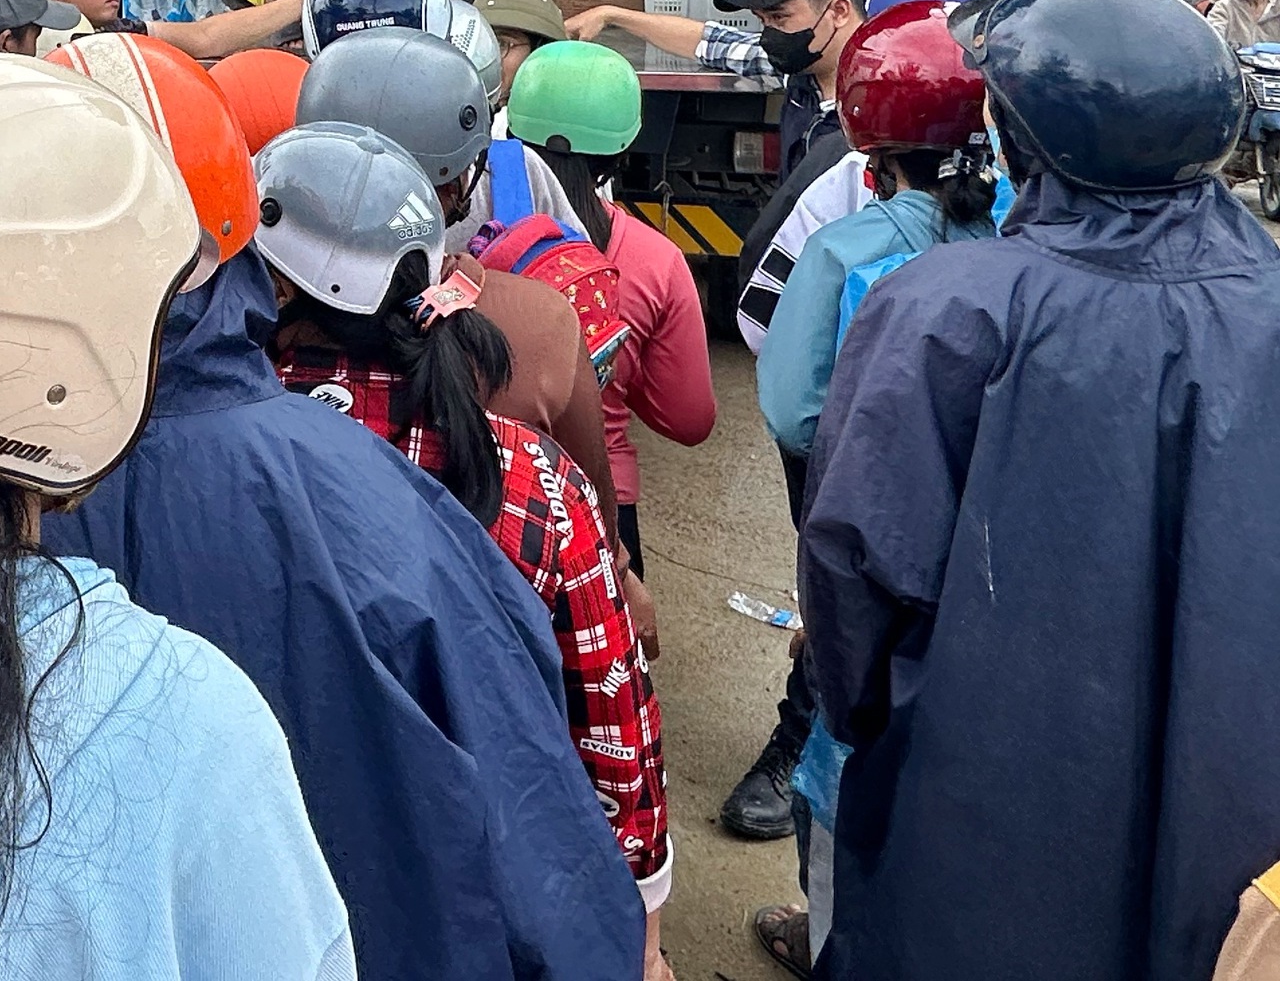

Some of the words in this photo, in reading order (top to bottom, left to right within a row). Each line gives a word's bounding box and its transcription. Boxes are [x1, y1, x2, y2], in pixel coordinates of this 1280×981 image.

[336, 21, 365, 32] QUANG
[365, 17, 395, 30] TRUNG
[398, 223, 433, 240] adidas
[523, 441, 573, 534] ADIDAS
[601, 657, 626, 698] NIKE
[582, 740, 634, 758] ADIDAS
